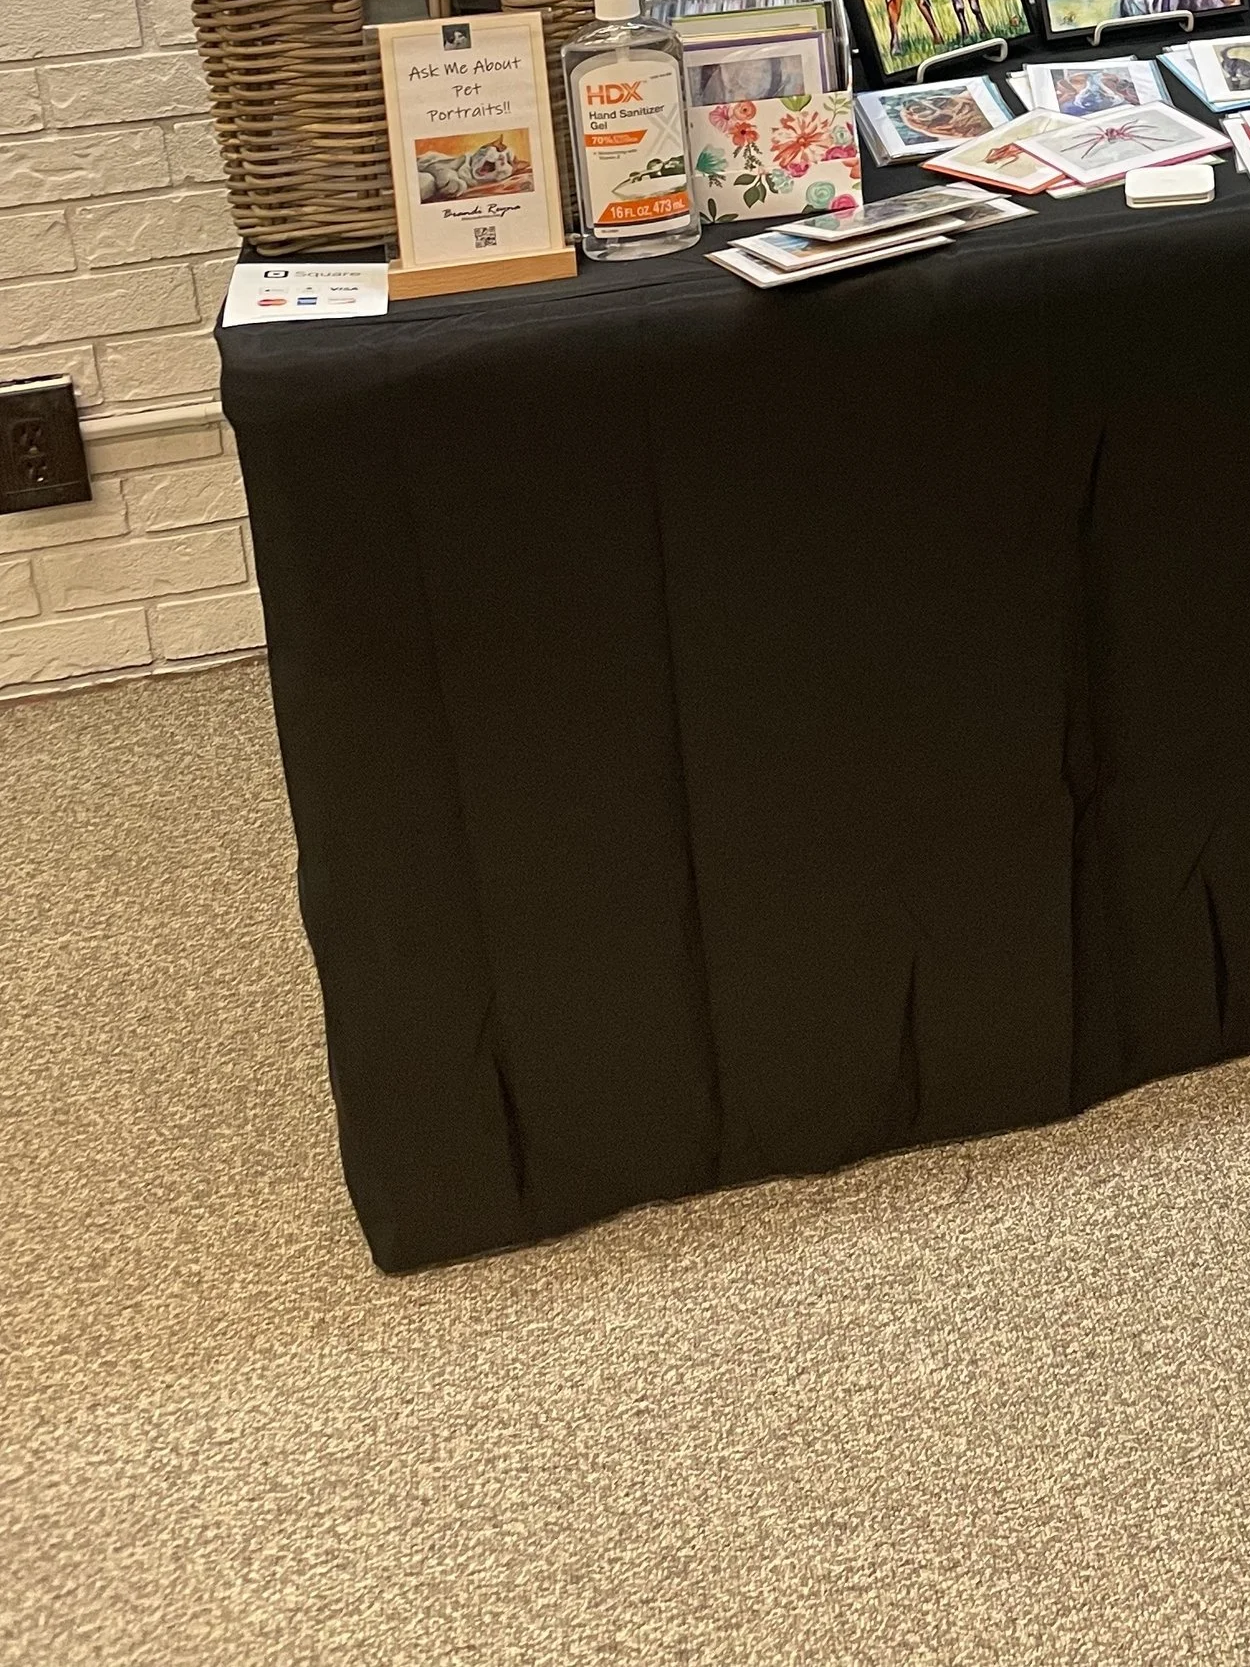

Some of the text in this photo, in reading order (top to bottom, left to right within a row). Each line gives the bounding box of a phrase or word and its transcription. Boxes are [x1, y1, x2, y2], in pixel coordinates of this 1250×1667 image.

[408, 56, 521, 81] Ask Me About
[452, 83, 482, 97] Pet
[586, 80, 643, 105] HDX
[426, 100, 512, 122] Portraits!!
[589, 105, 665, 120] Hand Sanitizer
[590, 121, 608, 130] Gel
[610, 206, 624, 219] 16
[624, 207, 636, 218] FL
[653, 199, 672, 213] 473
[673, 199, 686, 210] mL
